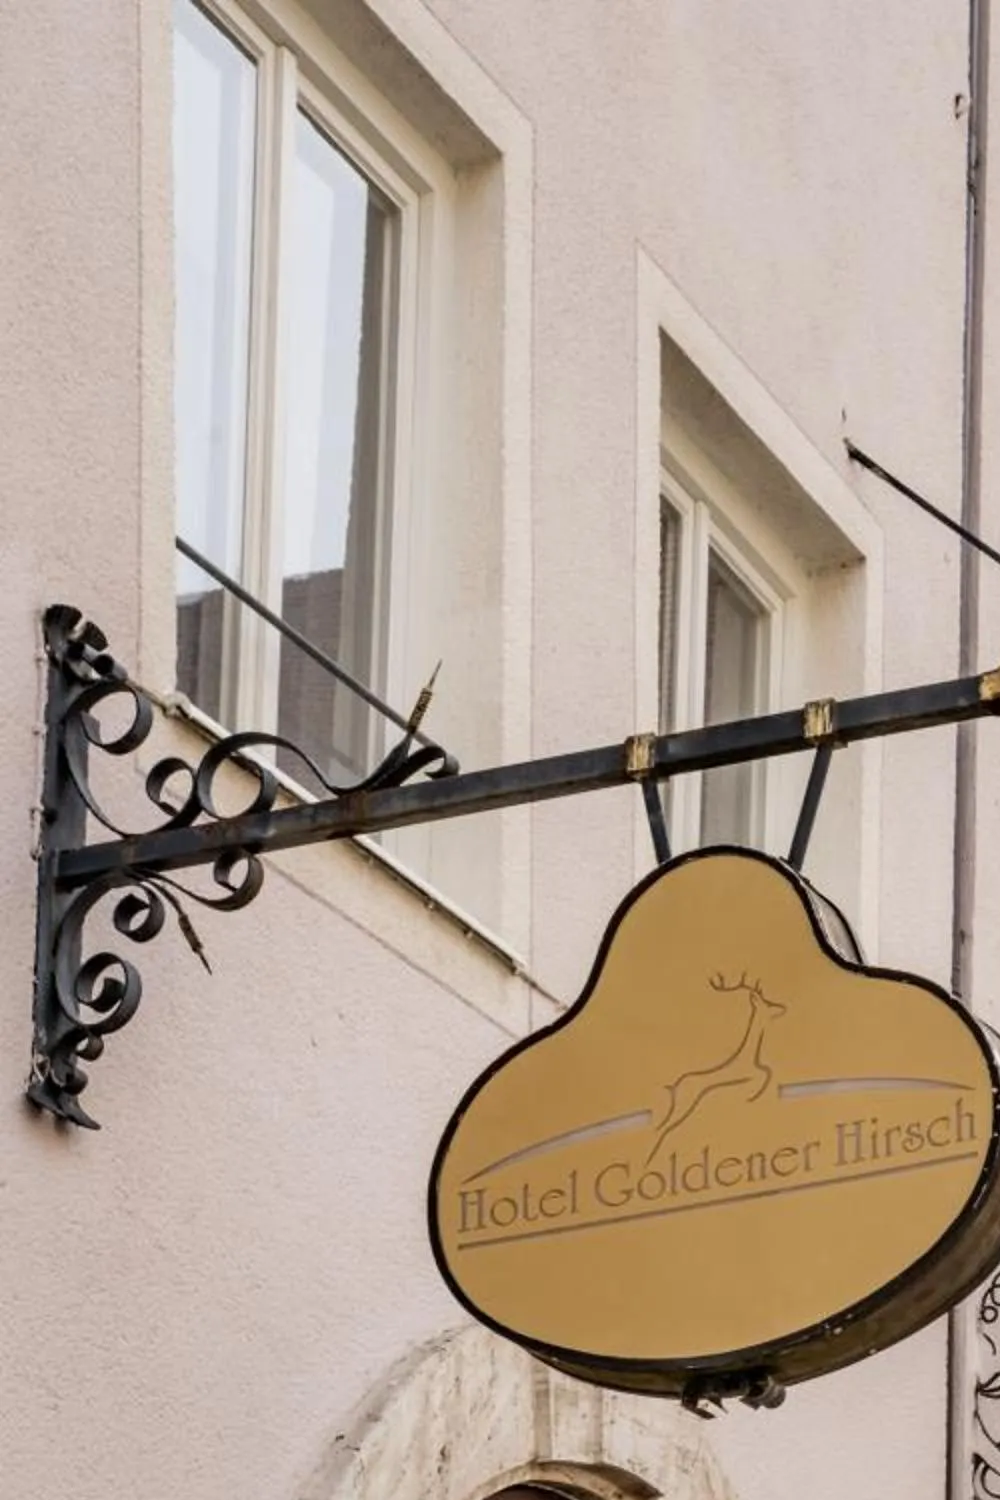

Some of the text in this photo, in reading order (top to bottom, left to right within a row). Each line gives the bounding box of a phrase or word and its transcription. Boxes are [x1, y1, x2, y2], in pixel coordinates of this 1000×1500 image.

[457, 1096, 978, 1234] Hotel Goldener Hirsch
